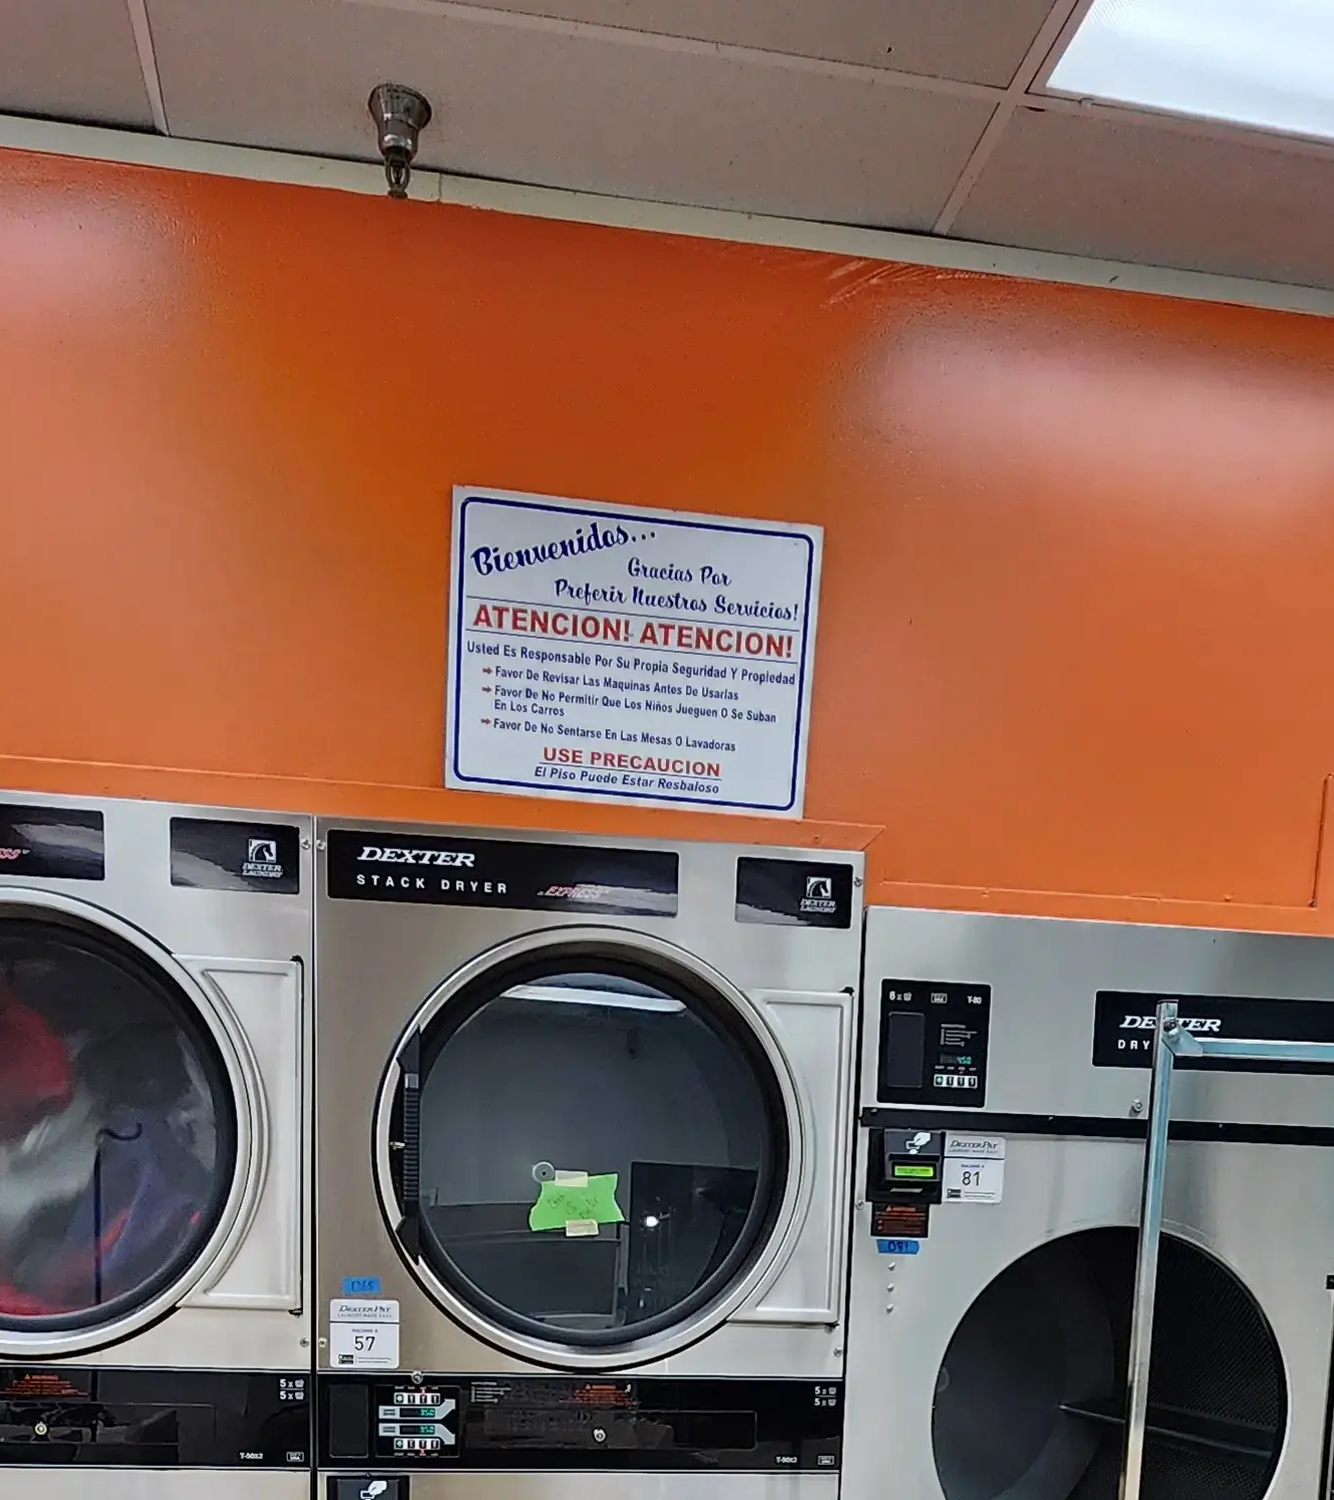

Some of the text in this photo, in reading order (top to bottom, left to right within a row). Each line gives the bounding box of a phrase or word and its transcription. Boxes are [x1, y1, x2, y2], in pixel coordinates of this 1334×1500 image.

[628, 557, 732, 586] Gracias Por
[555, 579, 798, 621] Preferir Nuestros Servicios!
[473, 604, 793, 658] ATENCION! ATENCION!
[467, 641, 795, 685] Usted Es Responsable Por Su Propia Seguridad Y Propiedad
[495, 666, 739, 700] Favor De Revisar Las Maquinas Antes De Usarlas
[494, 699, 565, 716] En Los Carros
[495, 685, 776, 722] Favor De No Permitir Que Los Niños Jueguen O Se Suban
[494, 718, 735, 751] Favor De No Sentarse En Las Mesas O Lavadoras
[544, 747, 720, 776] USE PRECAUCION
[534, 766, 719, 793] El Piso Puede Estar Resbaloso
[357, 846, 475, 868] DEXTER
[356, 875, 507, 894] STACK DRYER
[1119, 1016, 1221, 1031] DETER
[962, 1171, 980, 1186] 81
[355, 1336, 375, 1351] 57
